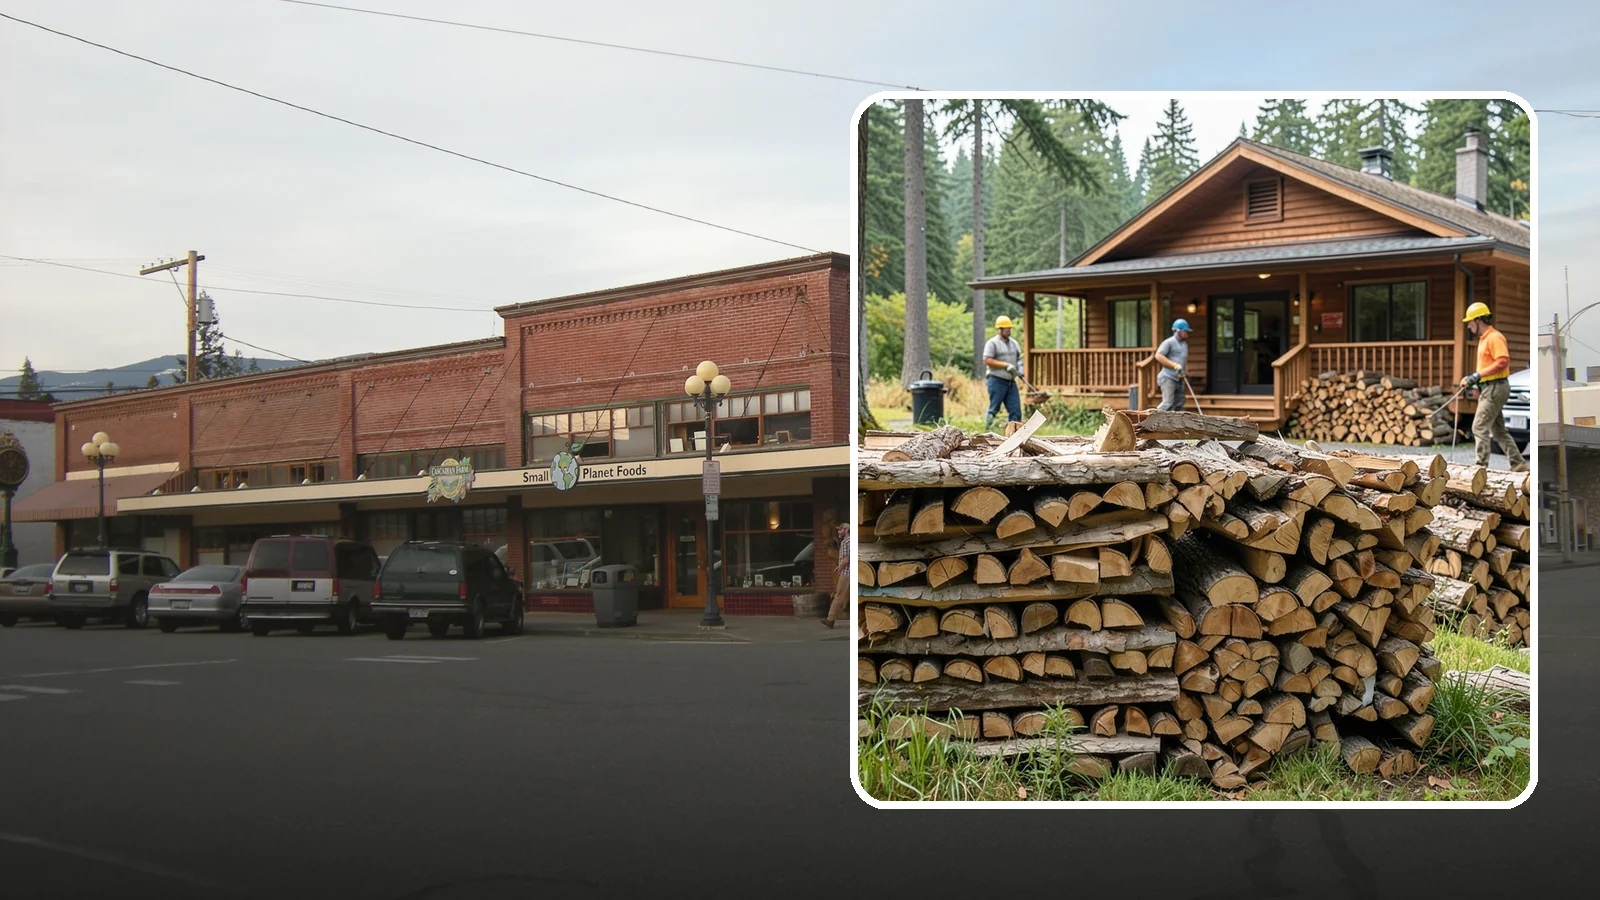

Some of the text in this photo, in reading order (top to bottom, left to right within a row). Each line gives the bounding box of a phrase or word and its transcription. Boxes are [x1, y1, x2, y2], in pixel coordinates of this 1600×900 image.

[522, 464, 647, 483] Small Planet Foods
